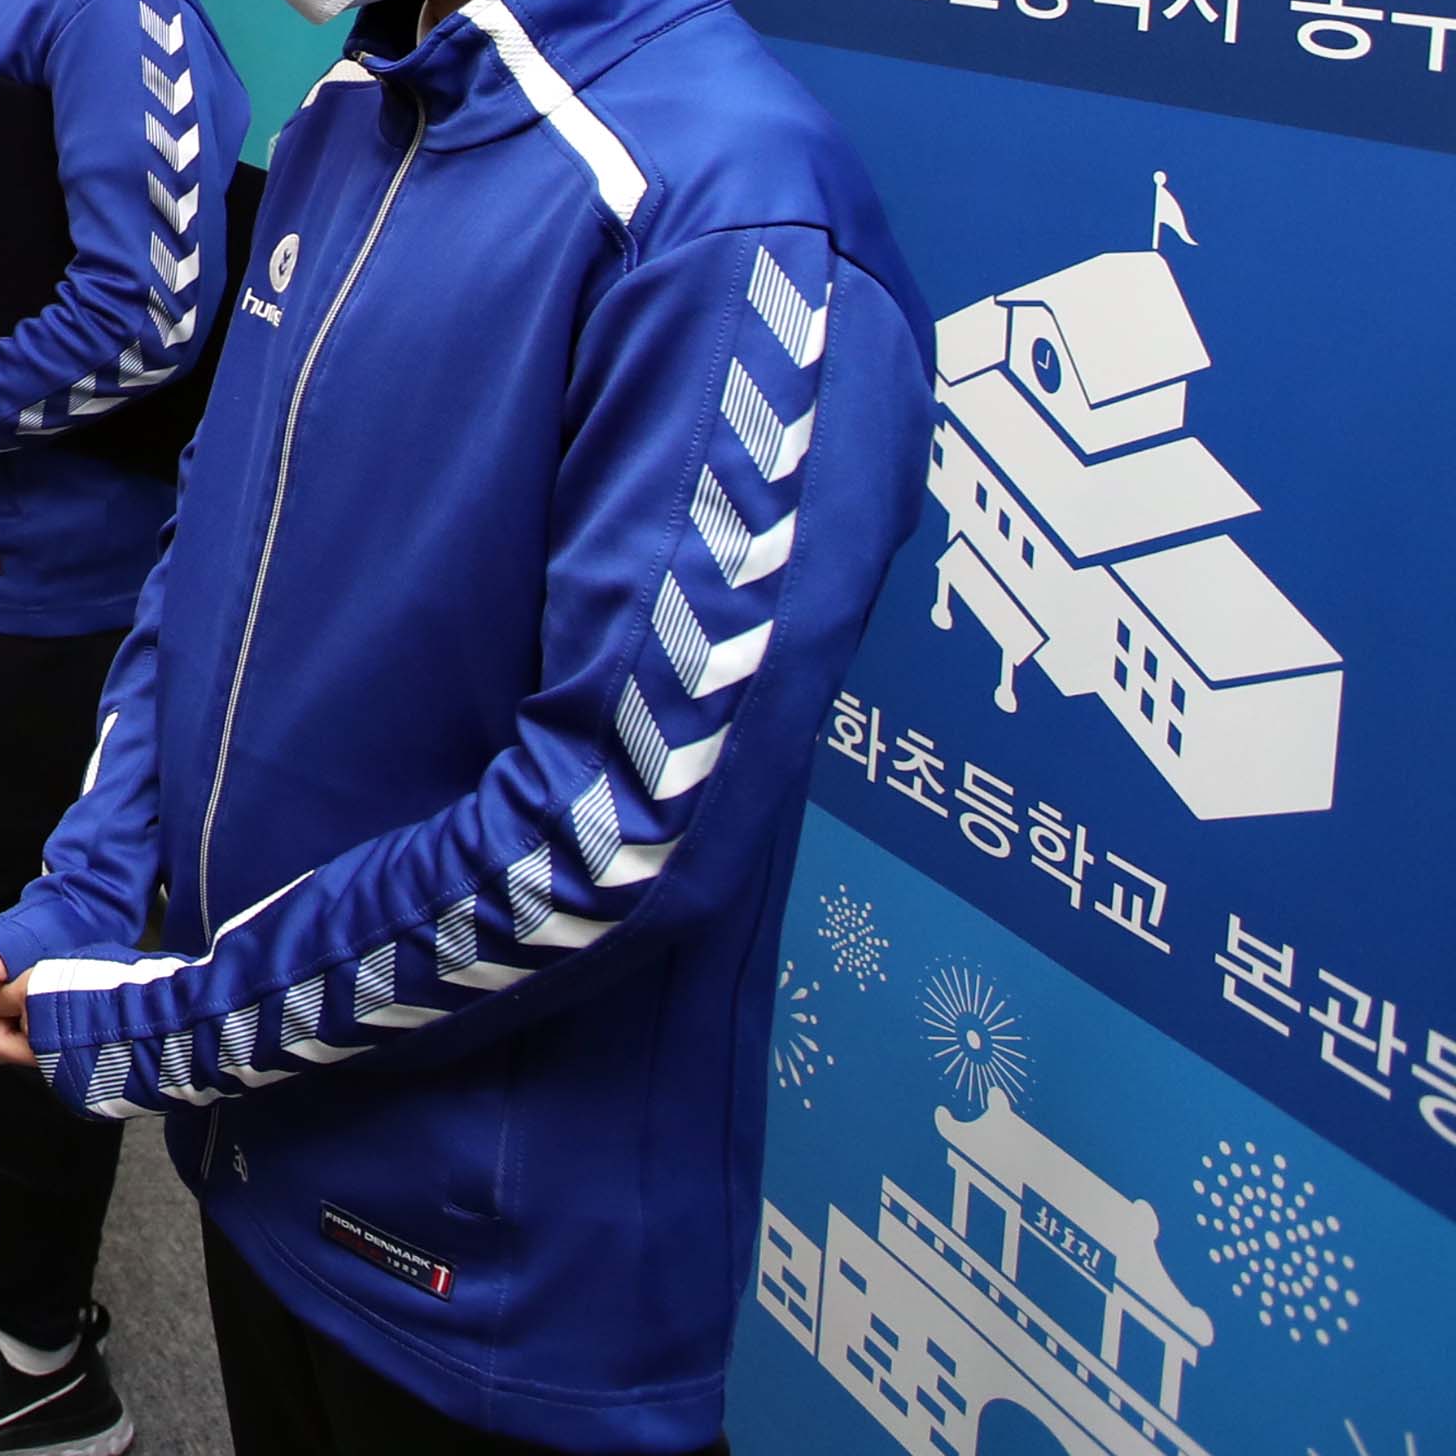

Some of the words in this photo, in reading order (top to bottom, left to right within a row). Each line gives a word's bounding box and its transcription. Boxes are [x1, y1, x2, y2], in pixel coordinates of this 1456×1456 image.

[826, 691, 1171, 955] 화초등학교
[325, 1210, 362, 1237] FROM
[363, 1230, 432, 1270] DENMARK
[1033, 1205, 1101, 1274] 화도진
